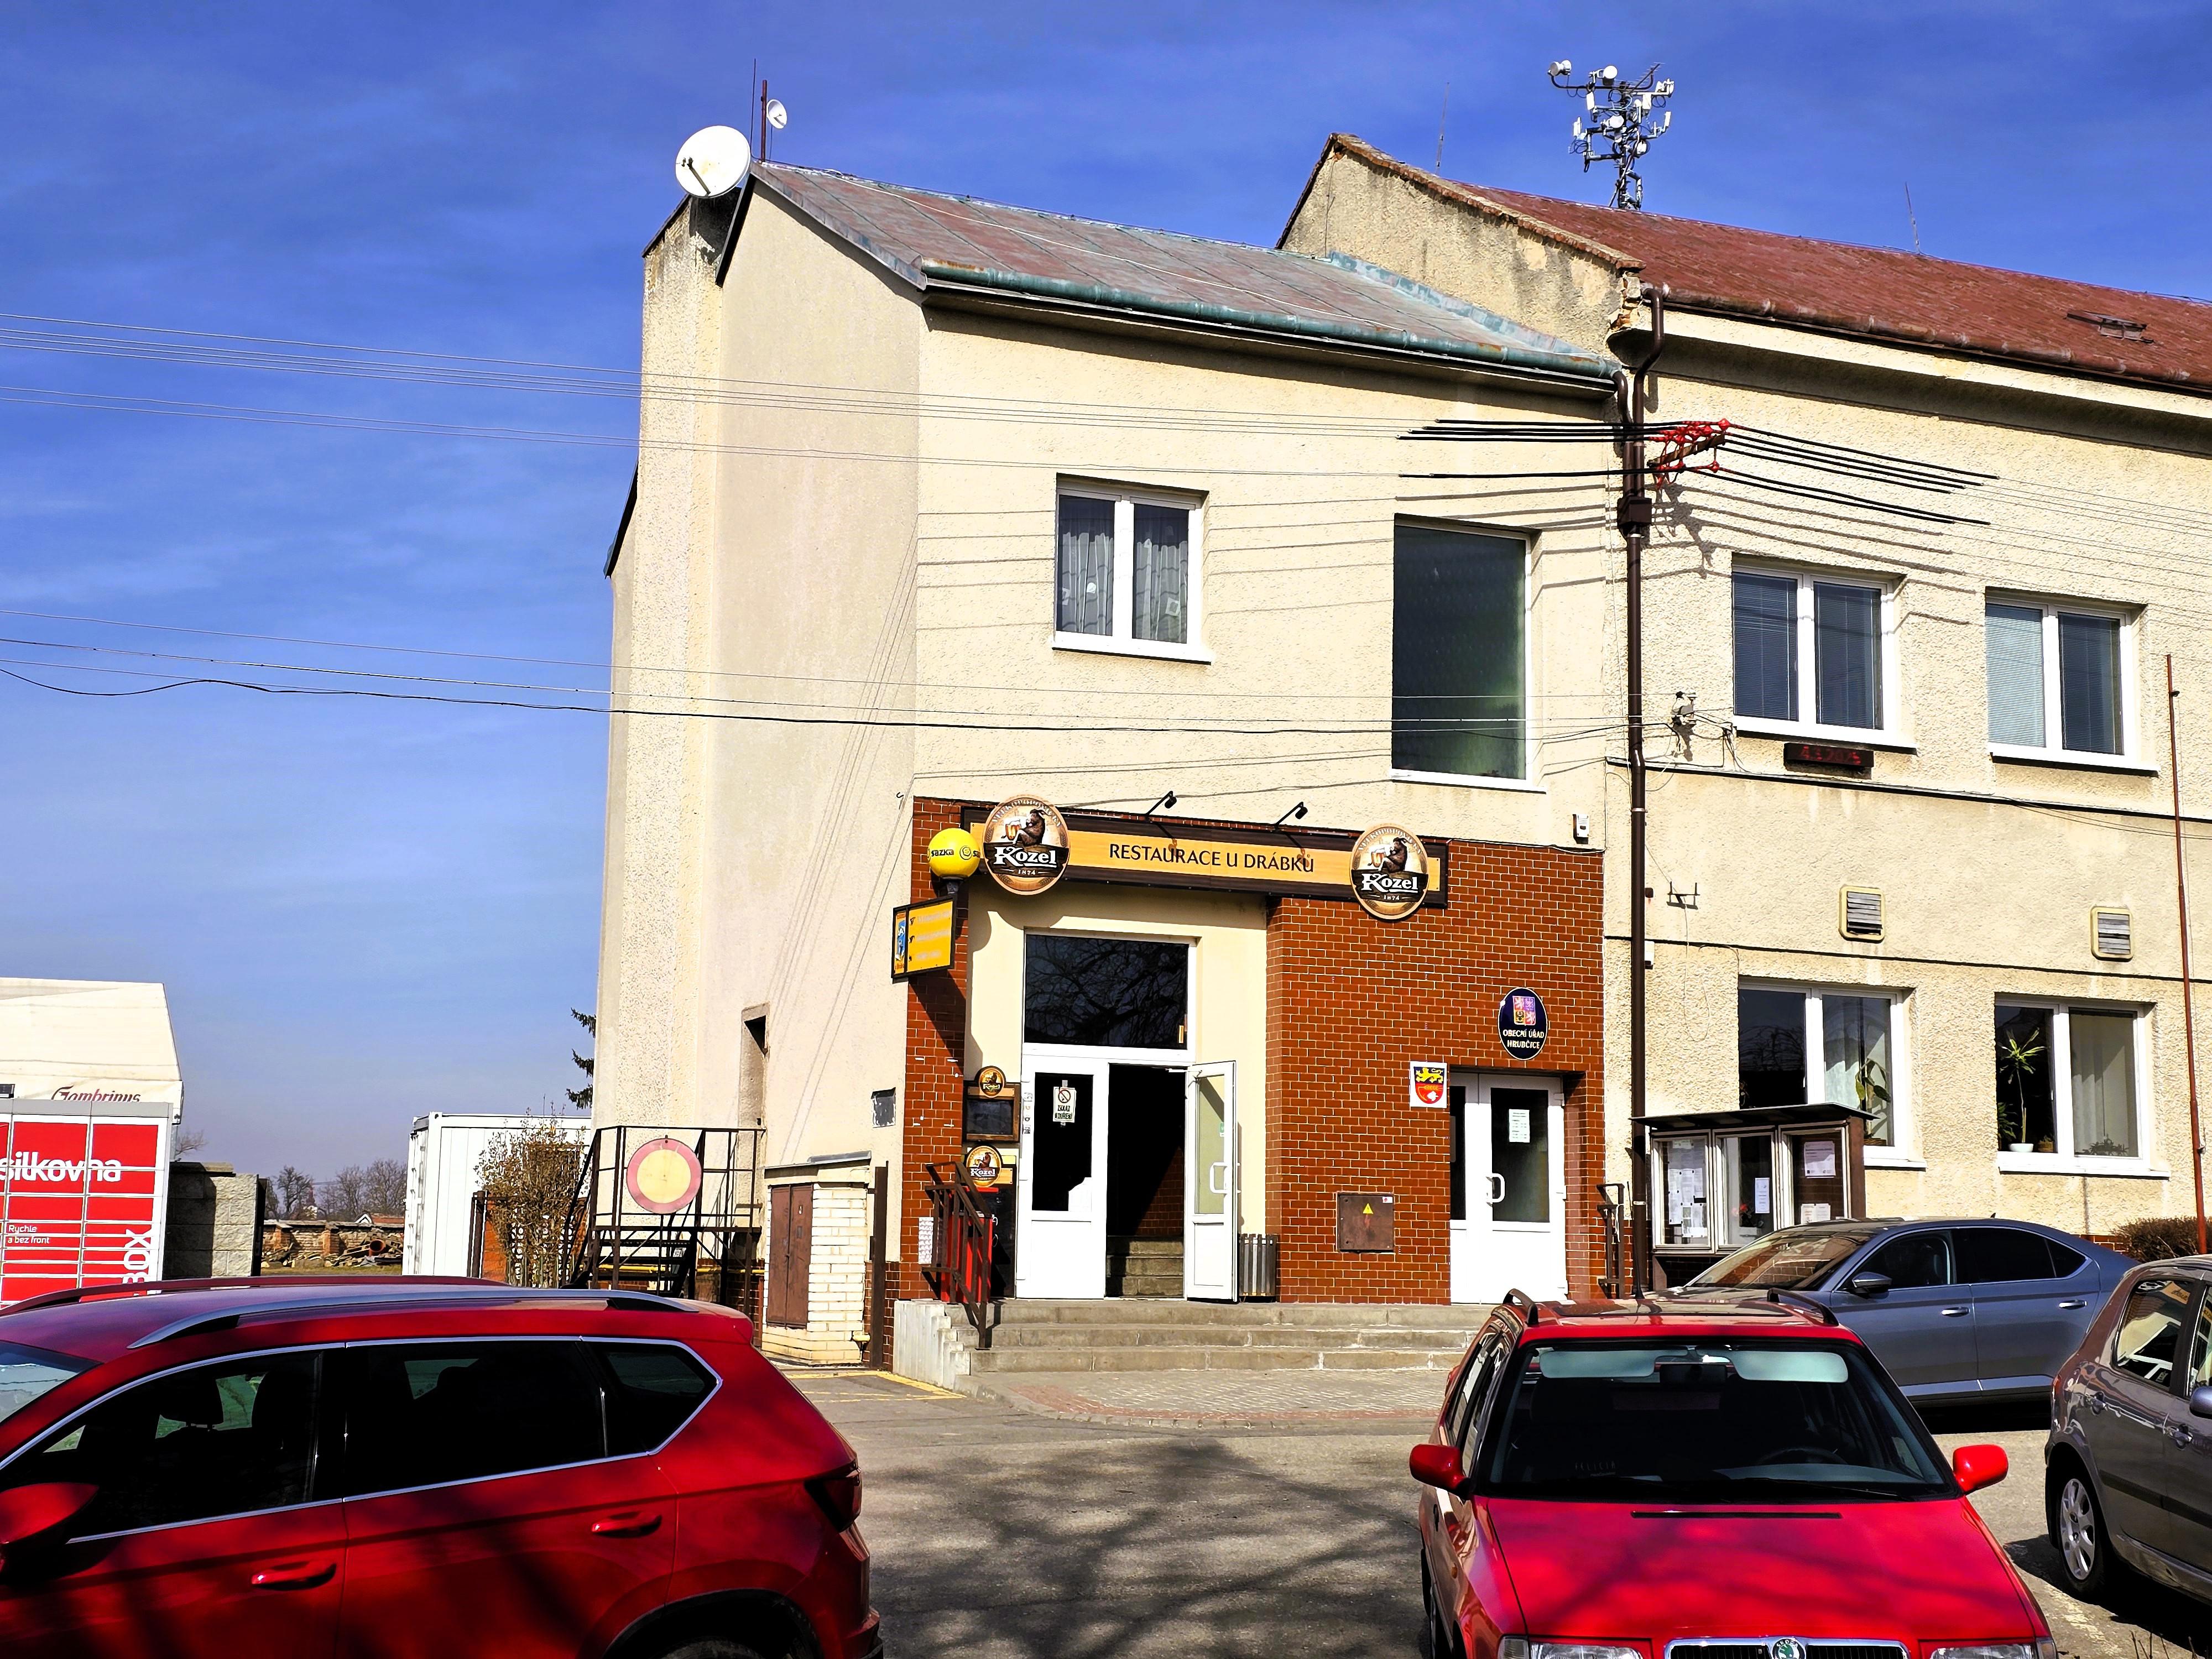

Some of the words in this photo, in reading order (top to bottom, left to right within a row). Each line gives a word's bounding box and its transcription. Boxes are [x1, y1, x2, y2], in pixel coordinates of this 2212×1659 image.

[993, 846, 1057, 868] Kozel
[1109, 843, 1222, 867] RESTAURACE
[1226, 852, 1238, 868] U
[1360, 873, 1418, 893] Kozel
[1503, 1029, 1527, 1037] OBECNÍ
[1528, 1029, 1545, 1038] ÚŘAD
[51, 1085, 141, 1102] Gambrinus
[970, 1168, 996, 1177] Kozel
[8, 1224, 38, 1233] Rychle
